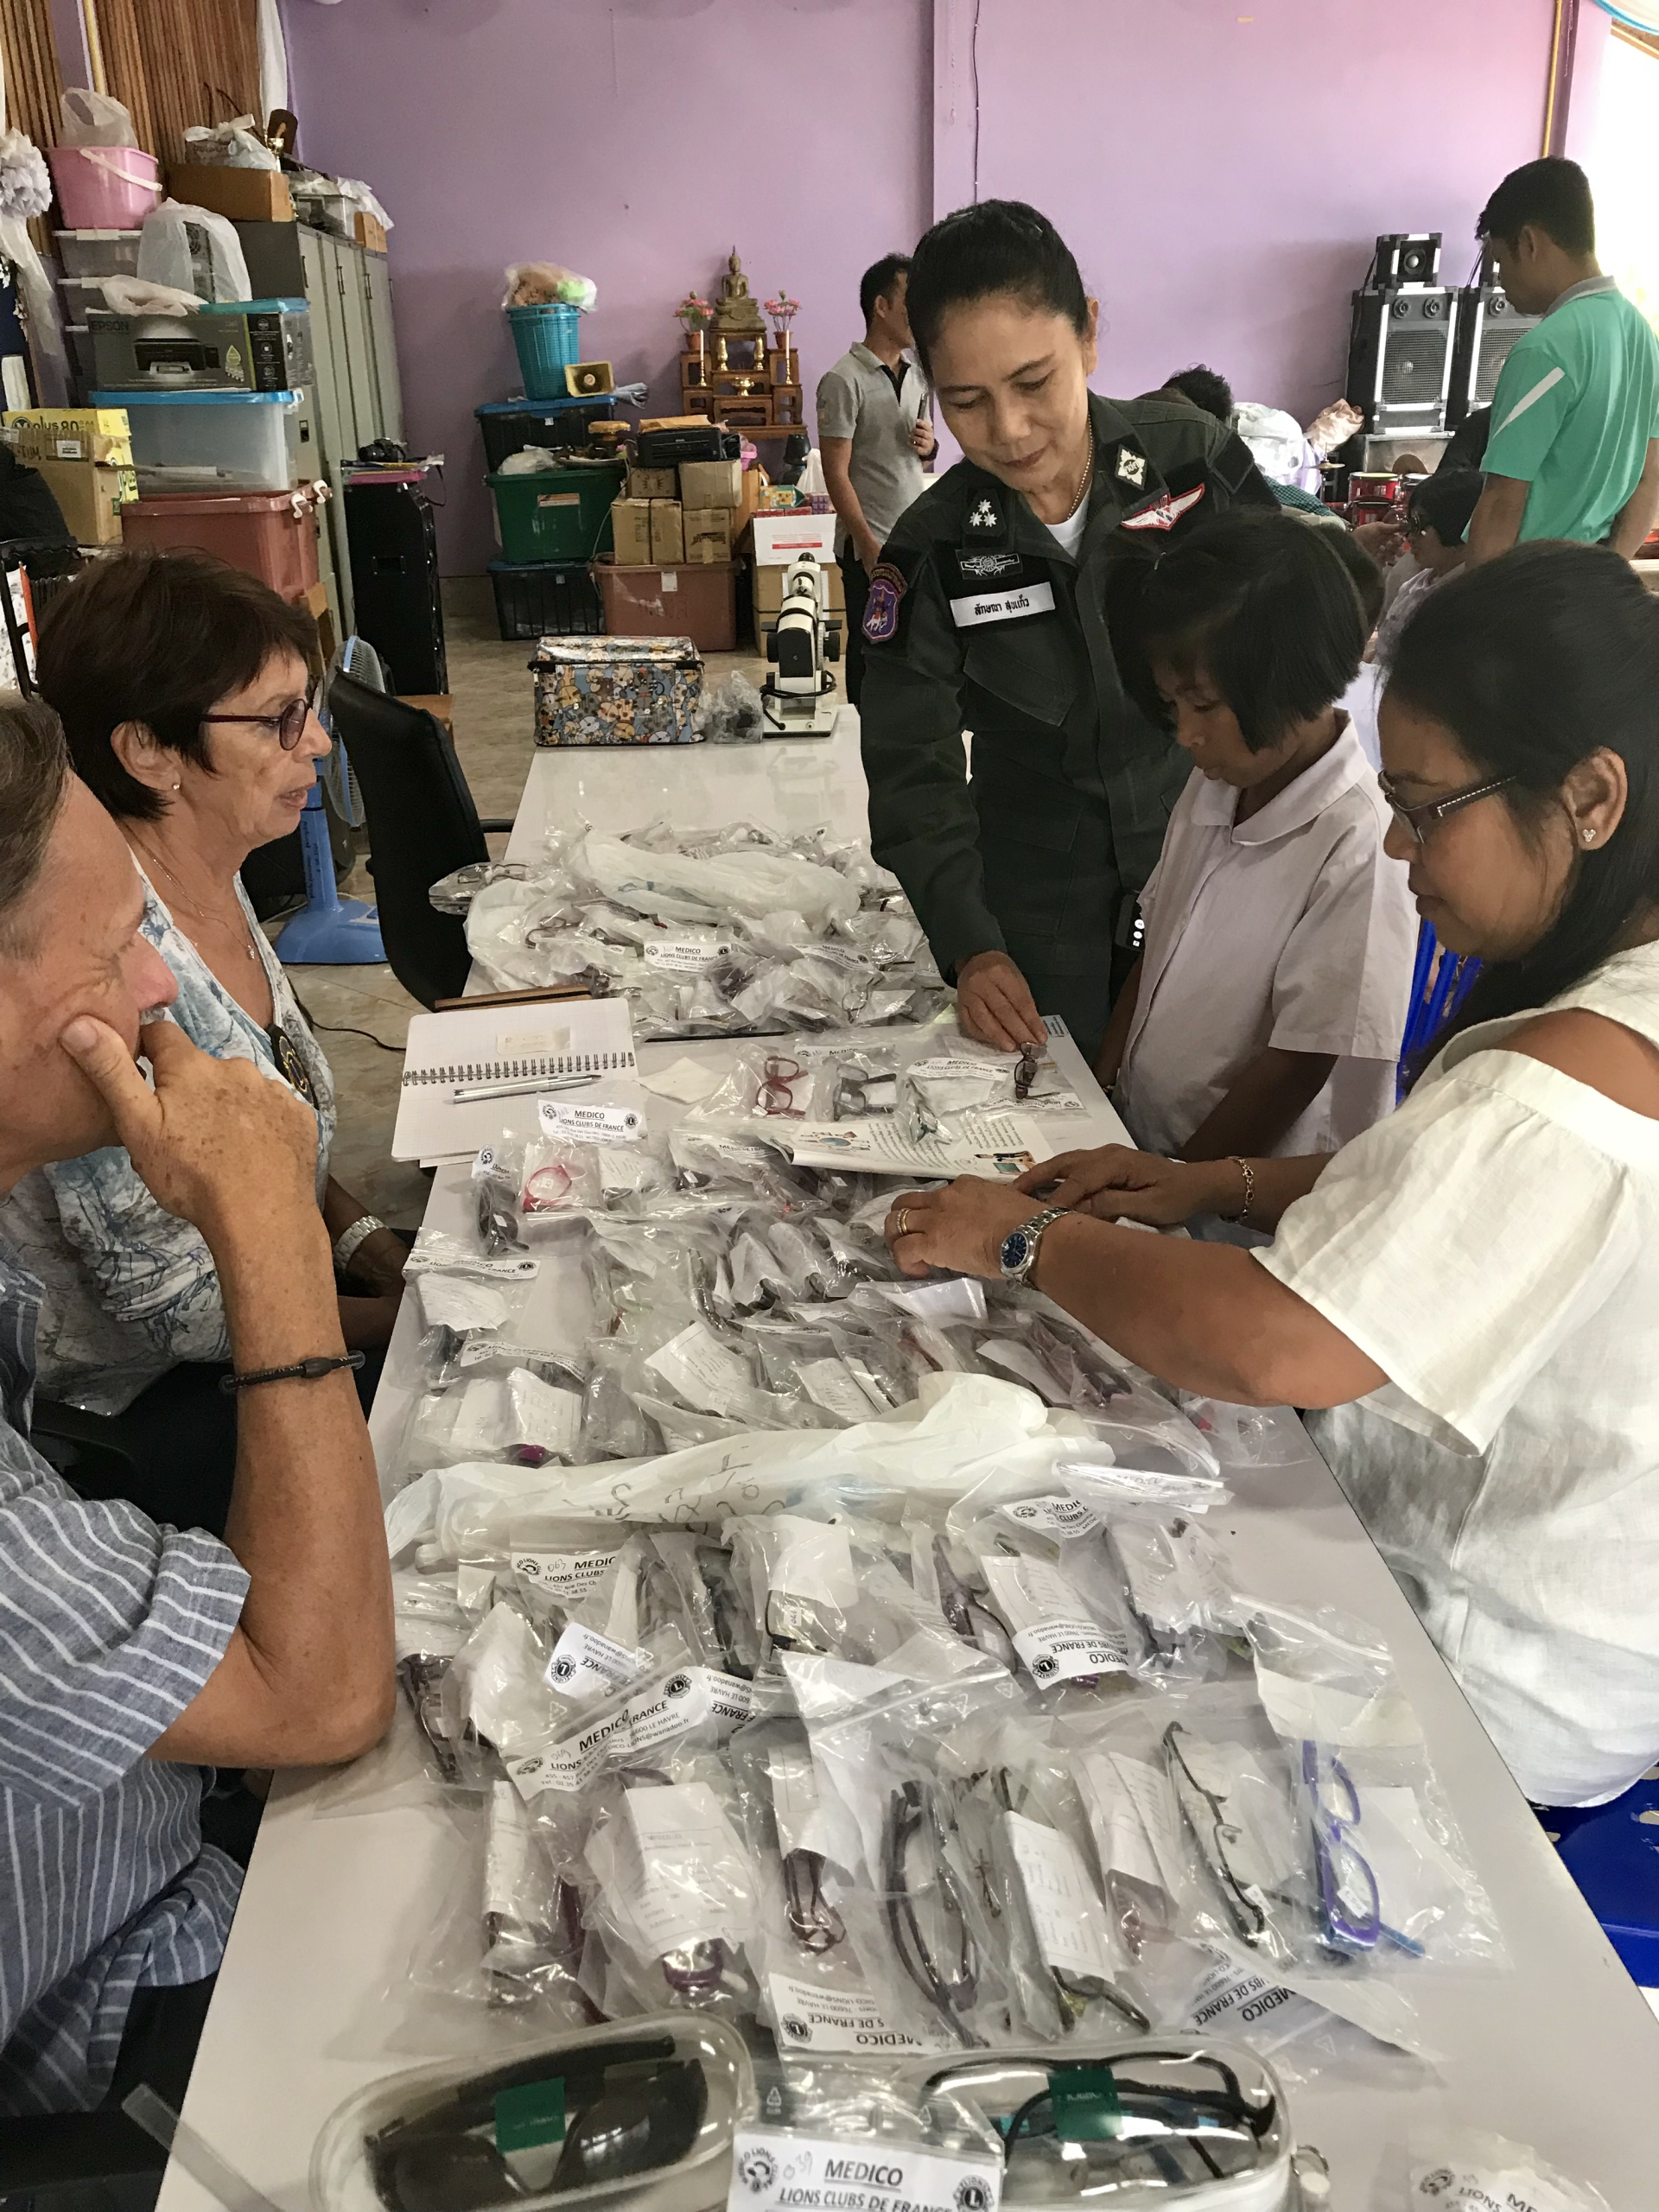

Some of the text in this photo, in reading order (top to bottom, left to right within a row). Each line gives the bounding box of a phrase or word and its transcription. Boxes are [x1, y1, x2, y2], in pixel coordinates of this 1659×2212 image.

[92, 321, 130, 332] EPSON
[33, 416, 58, 430] plus
[575, 1109, 605, 1121] MEDICO
[559, 1117, 575, 1126] LIONS
[575, 1119, 594, 1128] CLUBS
[602, 1122, 624, 1131] FRANCE
[1052, 1499, 1082, 1512] MEDIC
[547, 1558, 567, 1573] 063
[574, 1556, 616, 1570] MEDIC
[544, 1569, 605, 1583] LIONS CLUBS
[1037, 1632, 1057, 1643] HAVRE
[582, 1644, 604, 1659] HAVRE
[1051, 1642, 1085, 1654] FRANCE
[580, 1657, 621, 1684] FRANCE
[709, 1685, 750, 1704] 600 LE HAVRE
[711, 1702, 749, 1721] FRANCE
[648, 1720, 657, 1730] LE
[657, 1711, 681, 1726] HAVRE
[578, 1708, 630, 1752] MEDICO
[550, 1759, 582, 1770] LIONS
[1233, 1984, 1249, 2000] DE
[796, 1997, 820, 2009] HAVRE
[1192, 1993, 1234, 2026] FRANCE
[1242, 1986, 1296, 2023] MEDICO
[807, 2014, 855, 2029] FRANCE
[858, 2018, 874, 2030] DE
[824, 2158, 904, 2187] MEDICO
[779, 2187, 821, 2203] LIONS
[823, 2189, 870, 2209] CLUBS
[871, 2195, 891, 2212] DE
[1459, 2186, 1502, 2212] LIONS
